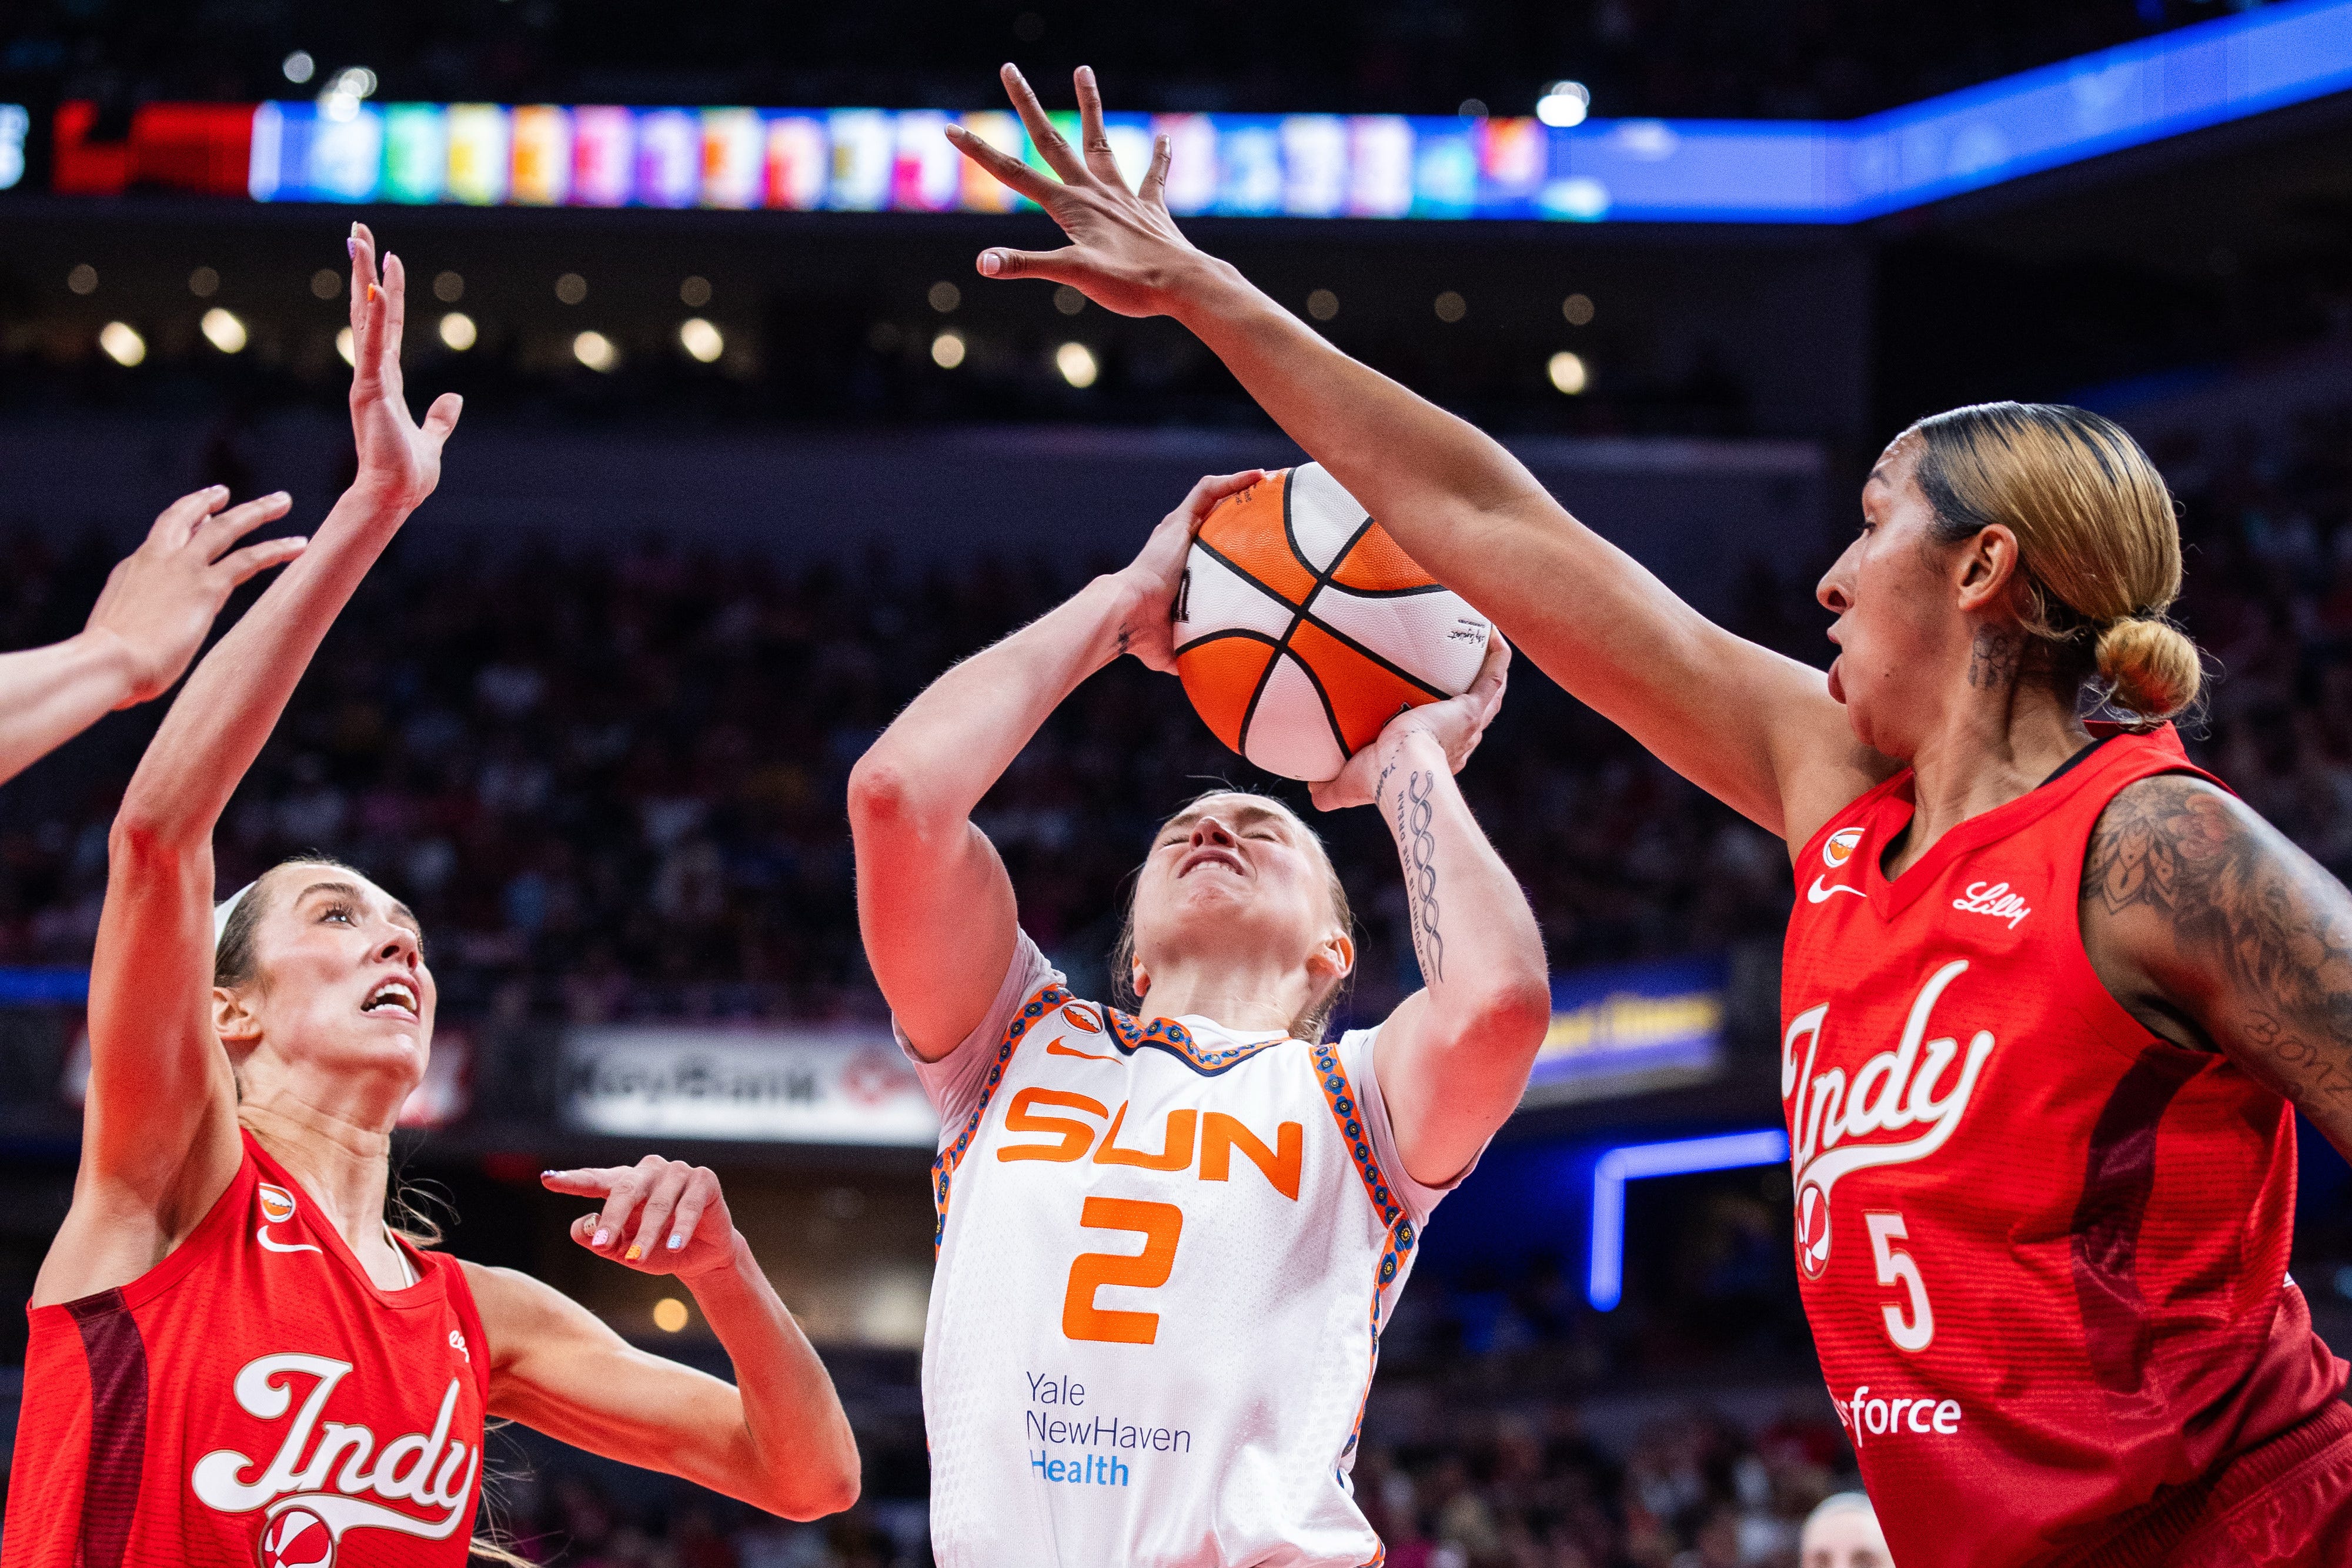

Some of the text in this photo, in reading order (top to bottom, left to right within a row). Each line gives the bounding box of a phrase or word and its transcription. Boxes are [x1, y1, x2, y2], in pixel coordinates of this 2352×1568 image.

[1397, 790, 1406, 842] DREAM
[1402, 845, 1411, 875] THE
[1412, 896, 1424, 956] JOURNEY
[1952, 881, 2032, 930] Lilly
[1782, 959, 1995, 1199] Indy
[996, 1086, 1304, 1201] SUN
[1062, 1196, 1184, 1345] 2
[1862, 1209, 1935, 1352] 5
[1026, 1371, 1085, 1406] Yale
[1827, 1385, 1962, 1448] force
[192, 1352, 478, 1541] Indy
[1027, 1410, 1191, 1453] NewHaven
[1030, 1449, 1129, 1486] Health
